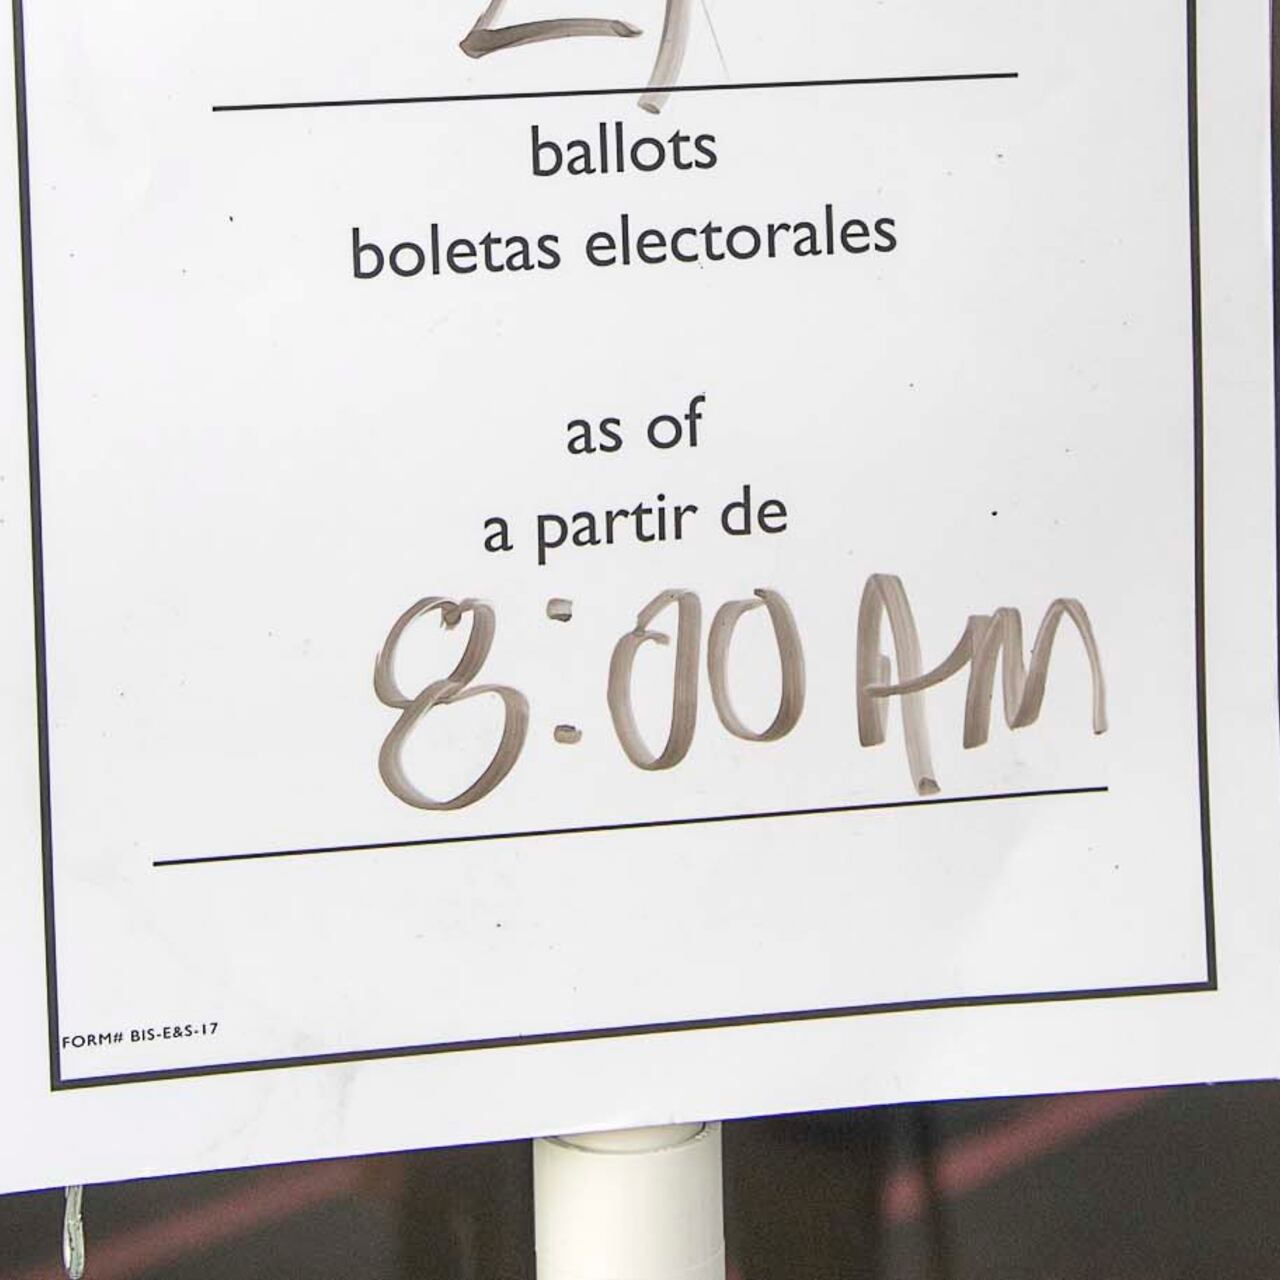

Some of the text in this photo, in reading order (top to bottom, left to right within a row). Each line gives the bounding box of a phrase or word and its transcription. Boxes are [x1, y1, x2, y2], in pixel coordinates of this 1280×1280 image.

[530, 120, 718, 177] ballots
[351, 203, 897, 280] boletas electorales
[566, 394, 706, 455] as of
[483, 484, 788, 566] a partir de
[373, 573, 1109, 812] 8:00 AM
[62, 1022, 219, 1050] FORM# BIS-E&S-17
